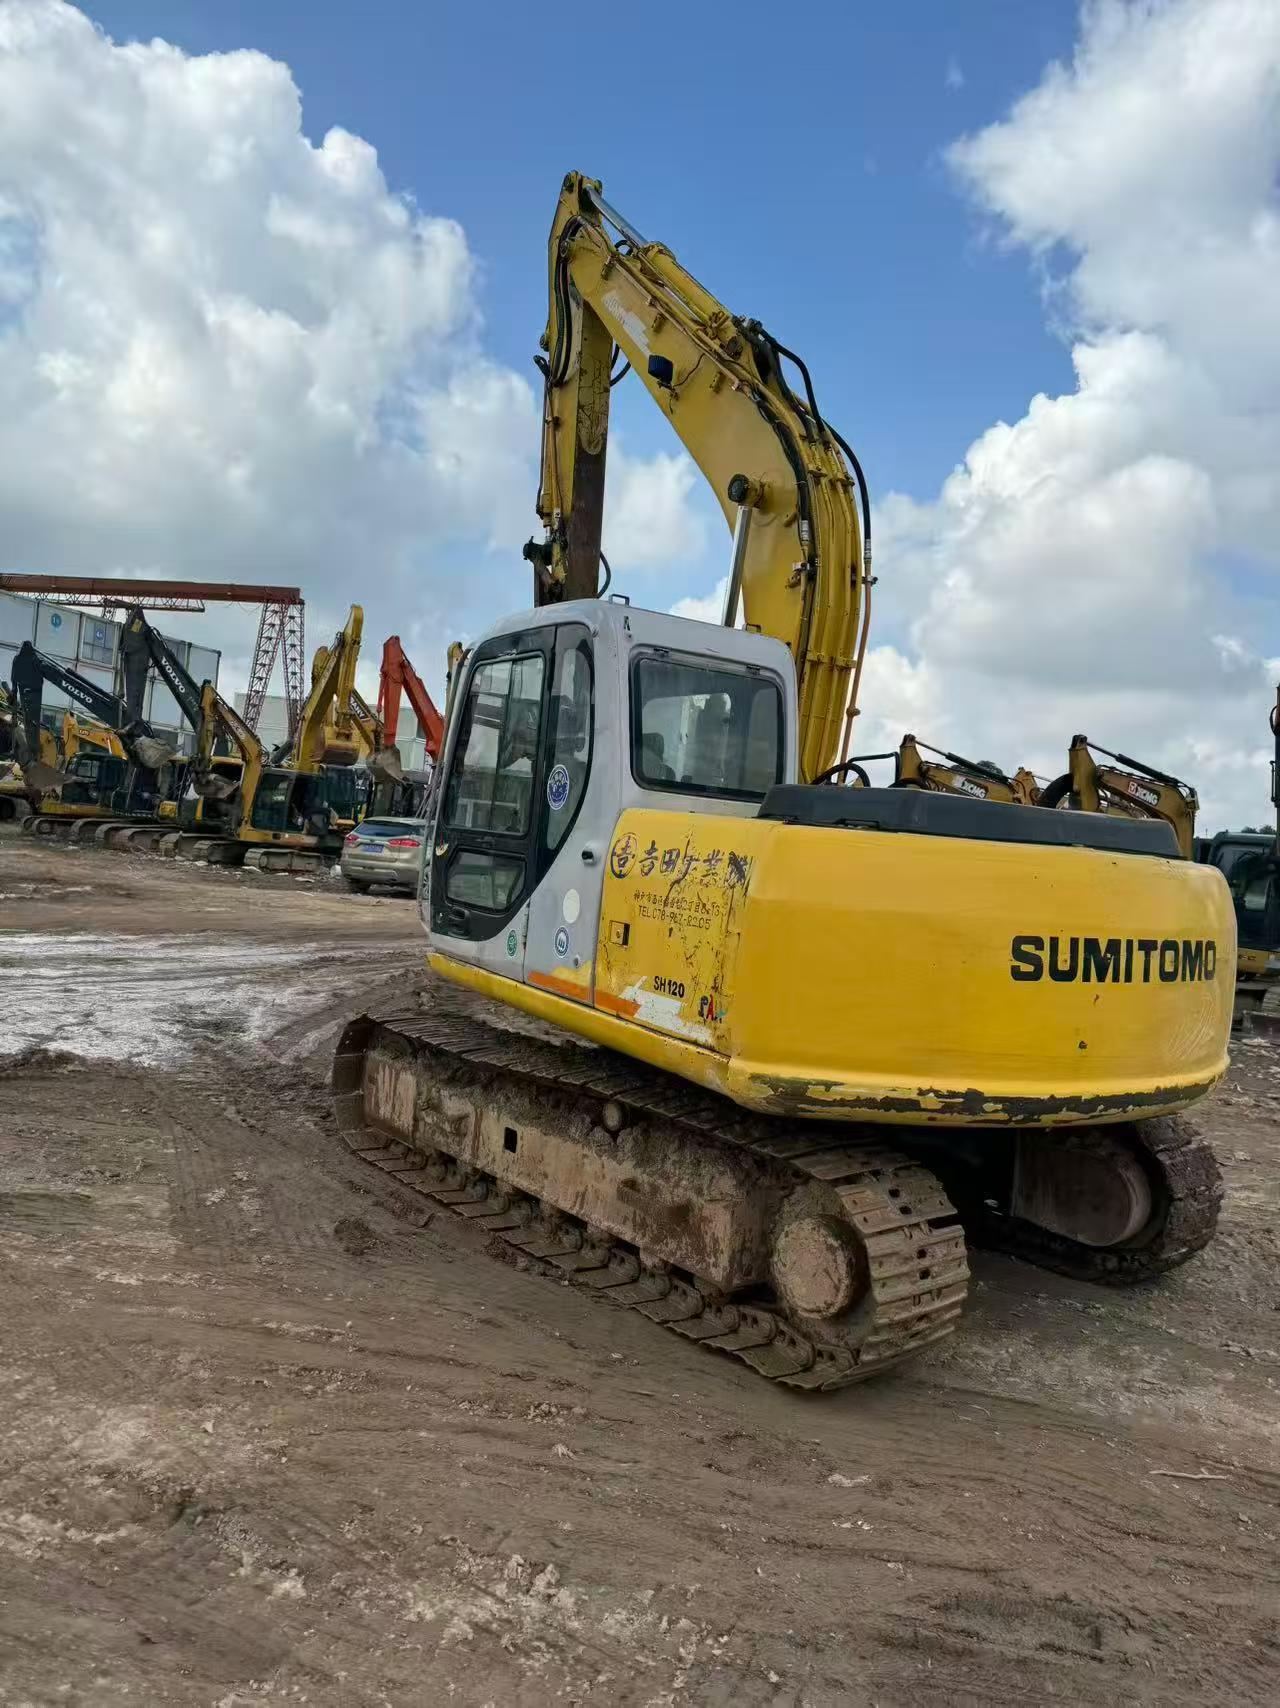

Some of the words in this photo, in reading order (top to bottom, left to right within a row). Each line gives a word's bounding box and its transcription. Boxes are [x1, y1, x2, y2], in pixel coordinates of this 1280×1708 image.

[161, 656, 186, 693] VOLVO
[61, 680, 93, 703] VOLVO
[963, 780, 986, 799] XCMG
[1135, 786, 1158, 806] XCMG
[1010, 935, 1216, 983] SUMITOMO
[653, 975, 685, 998] SH120
